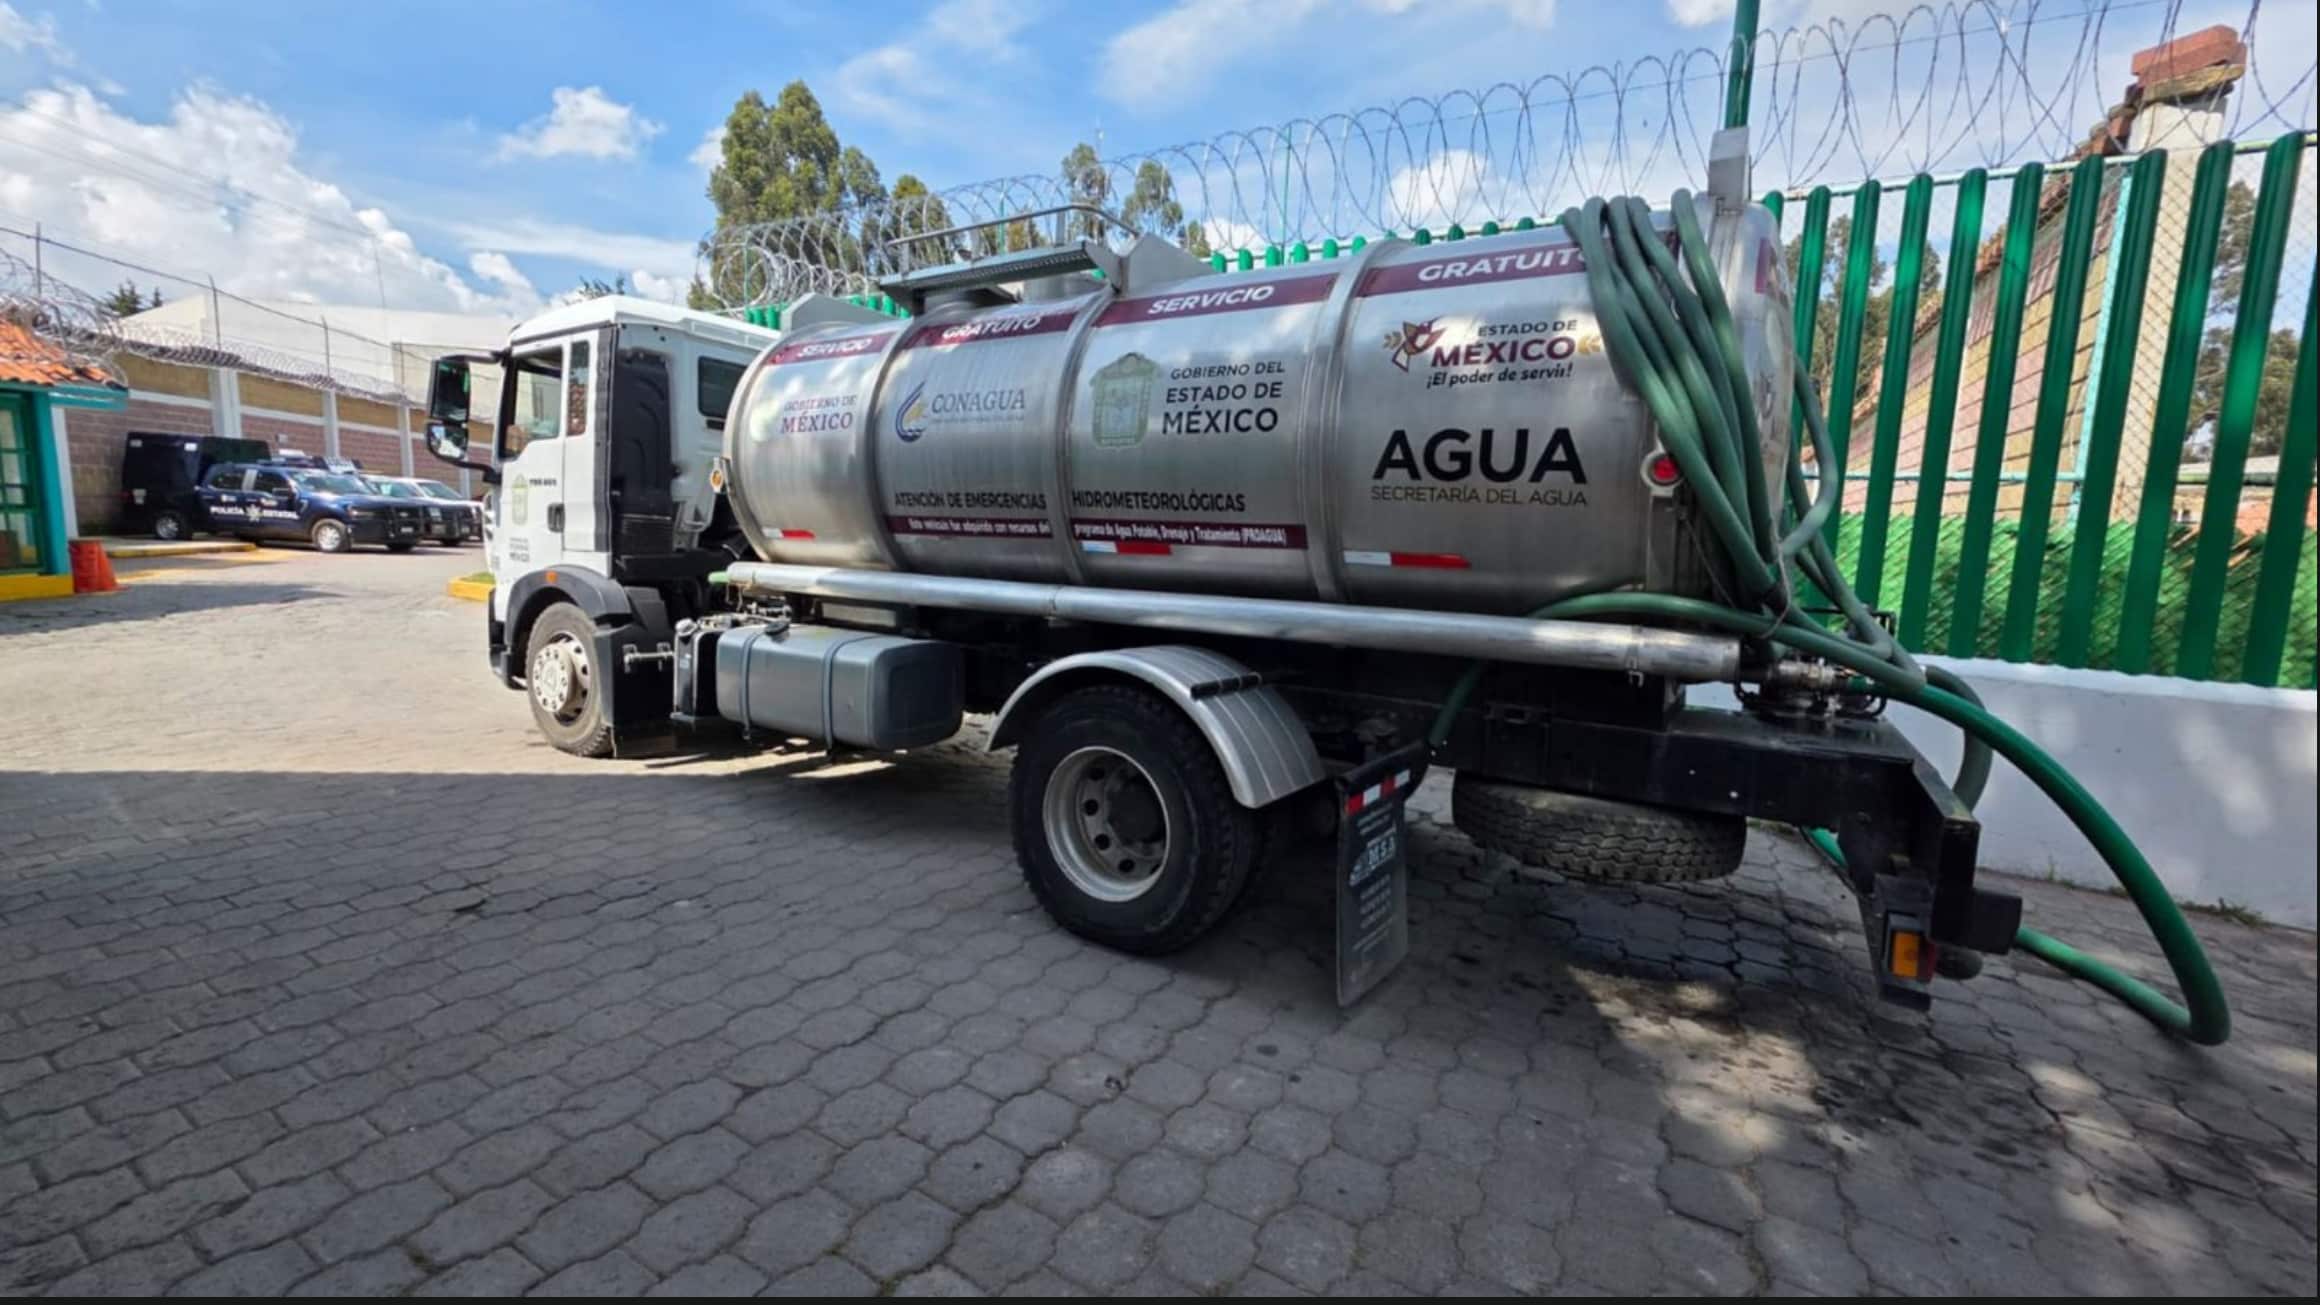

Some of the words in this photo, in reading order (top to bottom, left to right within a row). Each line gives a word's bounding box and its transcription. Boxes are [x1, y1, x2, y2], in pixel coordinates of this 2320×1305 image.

[1148, 285, 1274, 314] SERVICIO
[942, 316, 1041, 339] GRATUITO
[1478, 322, 1548, 337] ESTADO
[1552, 320, 1577, 332] DE
[1431, 337, 1575, 368] MÉXICO
[1171, 364, 1249, 380] GOBIERNO
[1255, 361, 1285, 375] DEL
[1427, 372, 1446, 389] ¡El
[1449, 369, 1493, 388] poder
[1498, 367, 1517, 381] de
[1520, 363, 1573, 380] servir!
[784, 397, 840, 412] GOBIERNO
[842, 395, 857, 406] DE
[931, 389, 1025, 414] CONAGUA
[1166, 384, 1246, 403] ESTADO
[1254, 382, 1283, 398] DE
[781, 411, 853, 433] MÉXICO
[1162, 405, 1278, 434] MÉXICO
[1372, 428, 1587, 484] AGUA
[947, 493, 963, 509] DE
[966, 493, 1047, 510] EMERGENCIAS
[1072, 489, 1245, 512] HIDROMETEOROLÓGICAS
[1371, 484, 1481, 503] SECRETARÍA
[1486, 487, 1522, 504] DEL
[1529, 489, 1587, 506] AGUA
